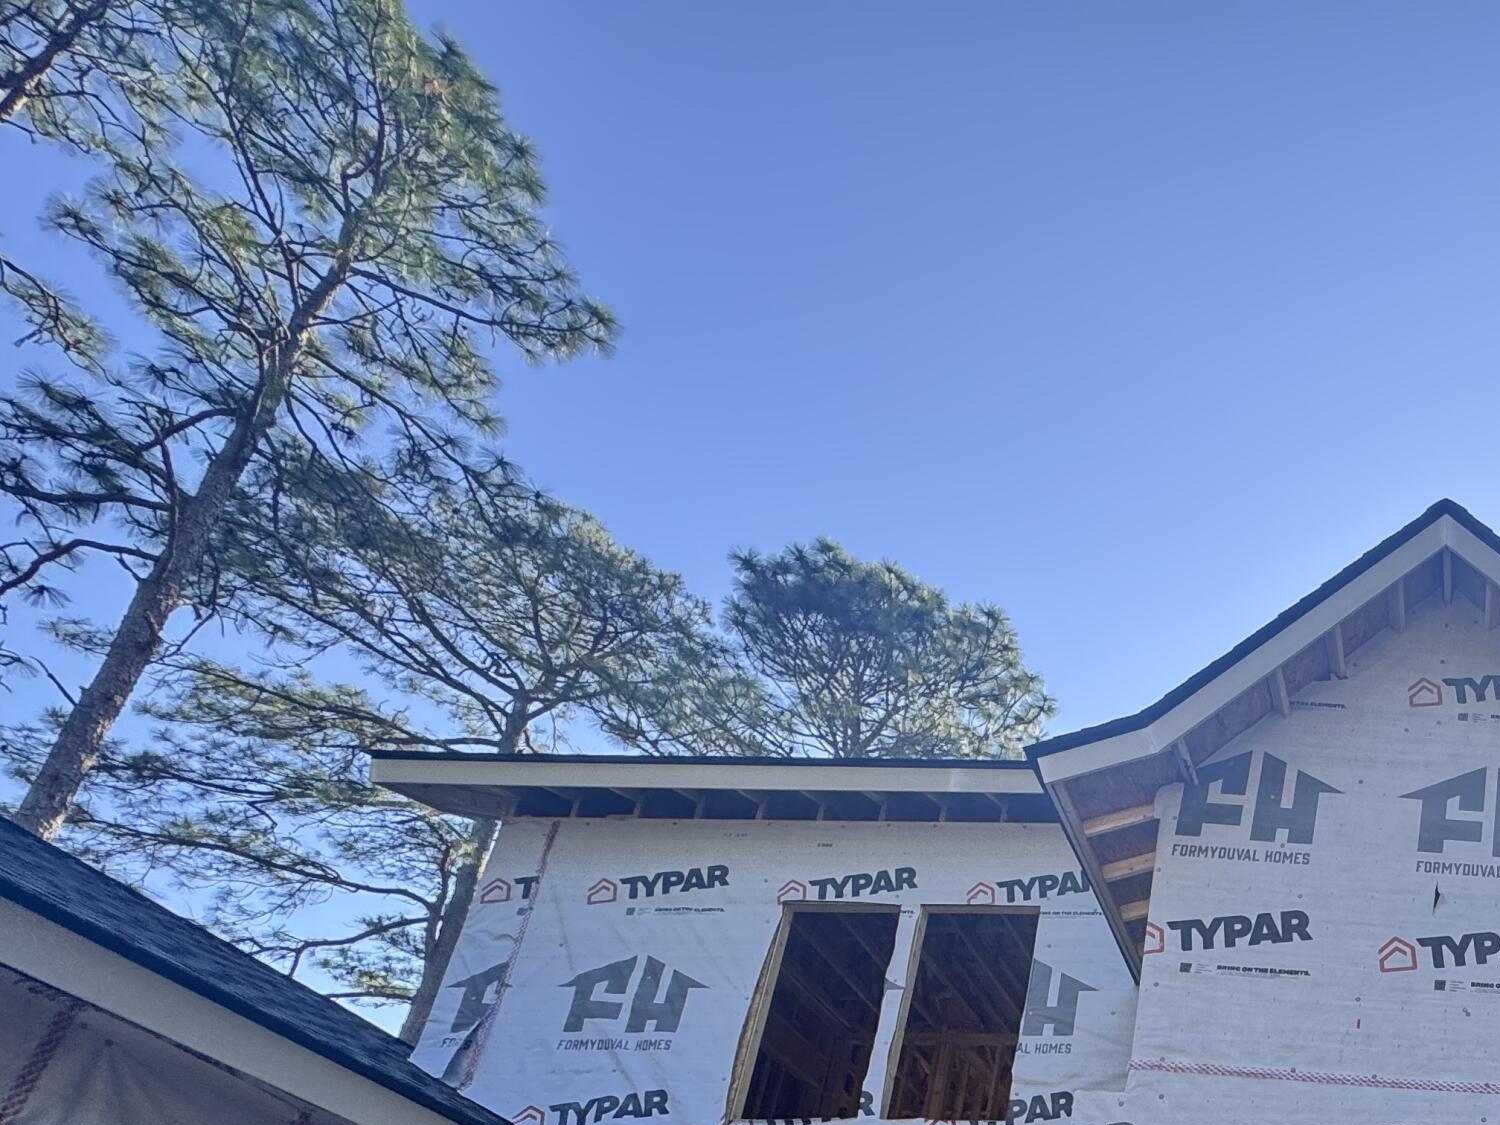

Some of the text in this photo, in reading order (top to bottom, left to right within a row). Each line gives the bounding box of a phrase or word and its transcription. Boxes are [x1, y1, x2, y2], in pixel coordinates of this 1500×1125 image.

[1171, 843, 1311, 865] FORMYDUVAL HOMES
[619, 864, 729, 899] TYPAR
[808, 866, 918, 900] TYPAR
[995, 869, 1095, 903] TYPA
[1166, 910, 1313, 951] TYPAR
[556, 1039, 672, 1051] FORMYDUVAL HOMES
[1034, 1043, 1072, 1054] HOMES
